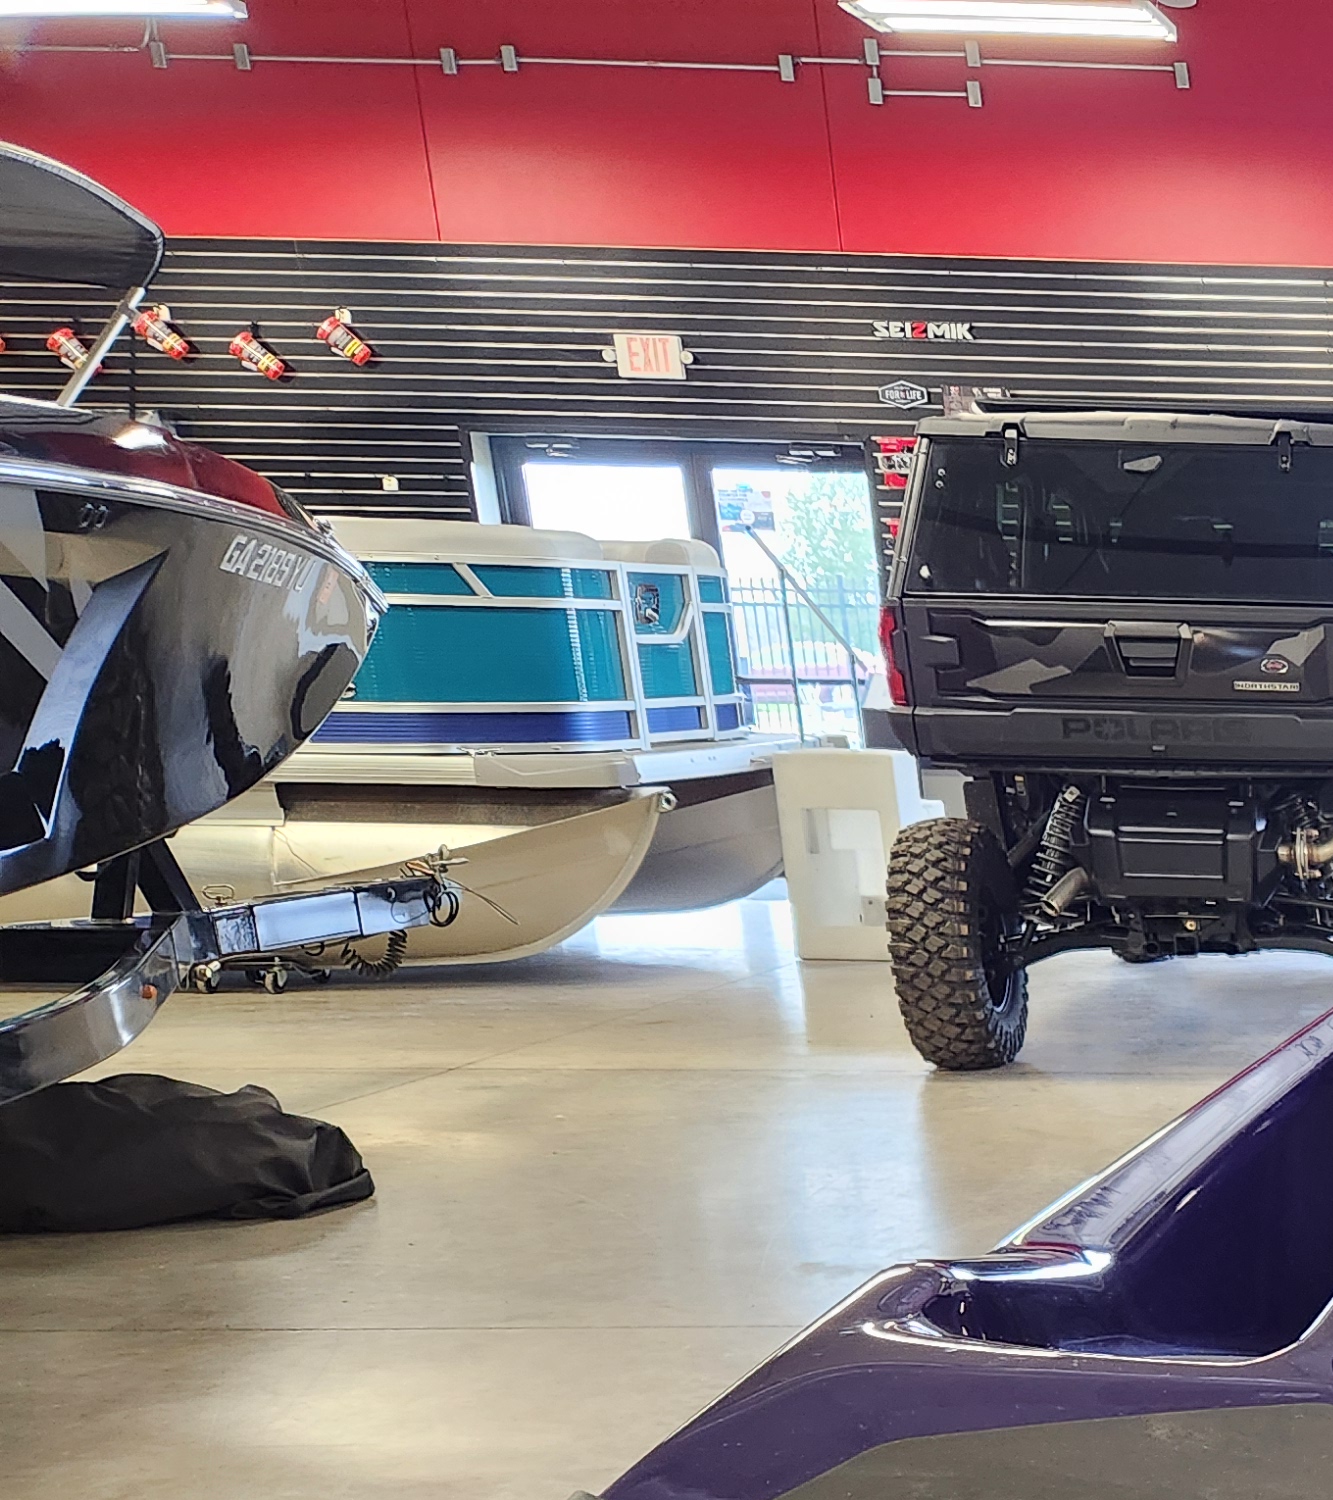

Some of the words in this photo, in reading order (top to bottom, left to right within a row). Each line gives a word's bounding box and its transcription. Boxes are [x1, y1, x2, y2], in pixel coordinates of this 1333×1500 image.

[872, 320, 974, 341] SEIZMIK
[627, 336, 672, 374] EXIT
[220, 535, 258, 576] GA
[286, 556, 317, 592] YU
[1062, 717, 1251, 742] POLARIS
